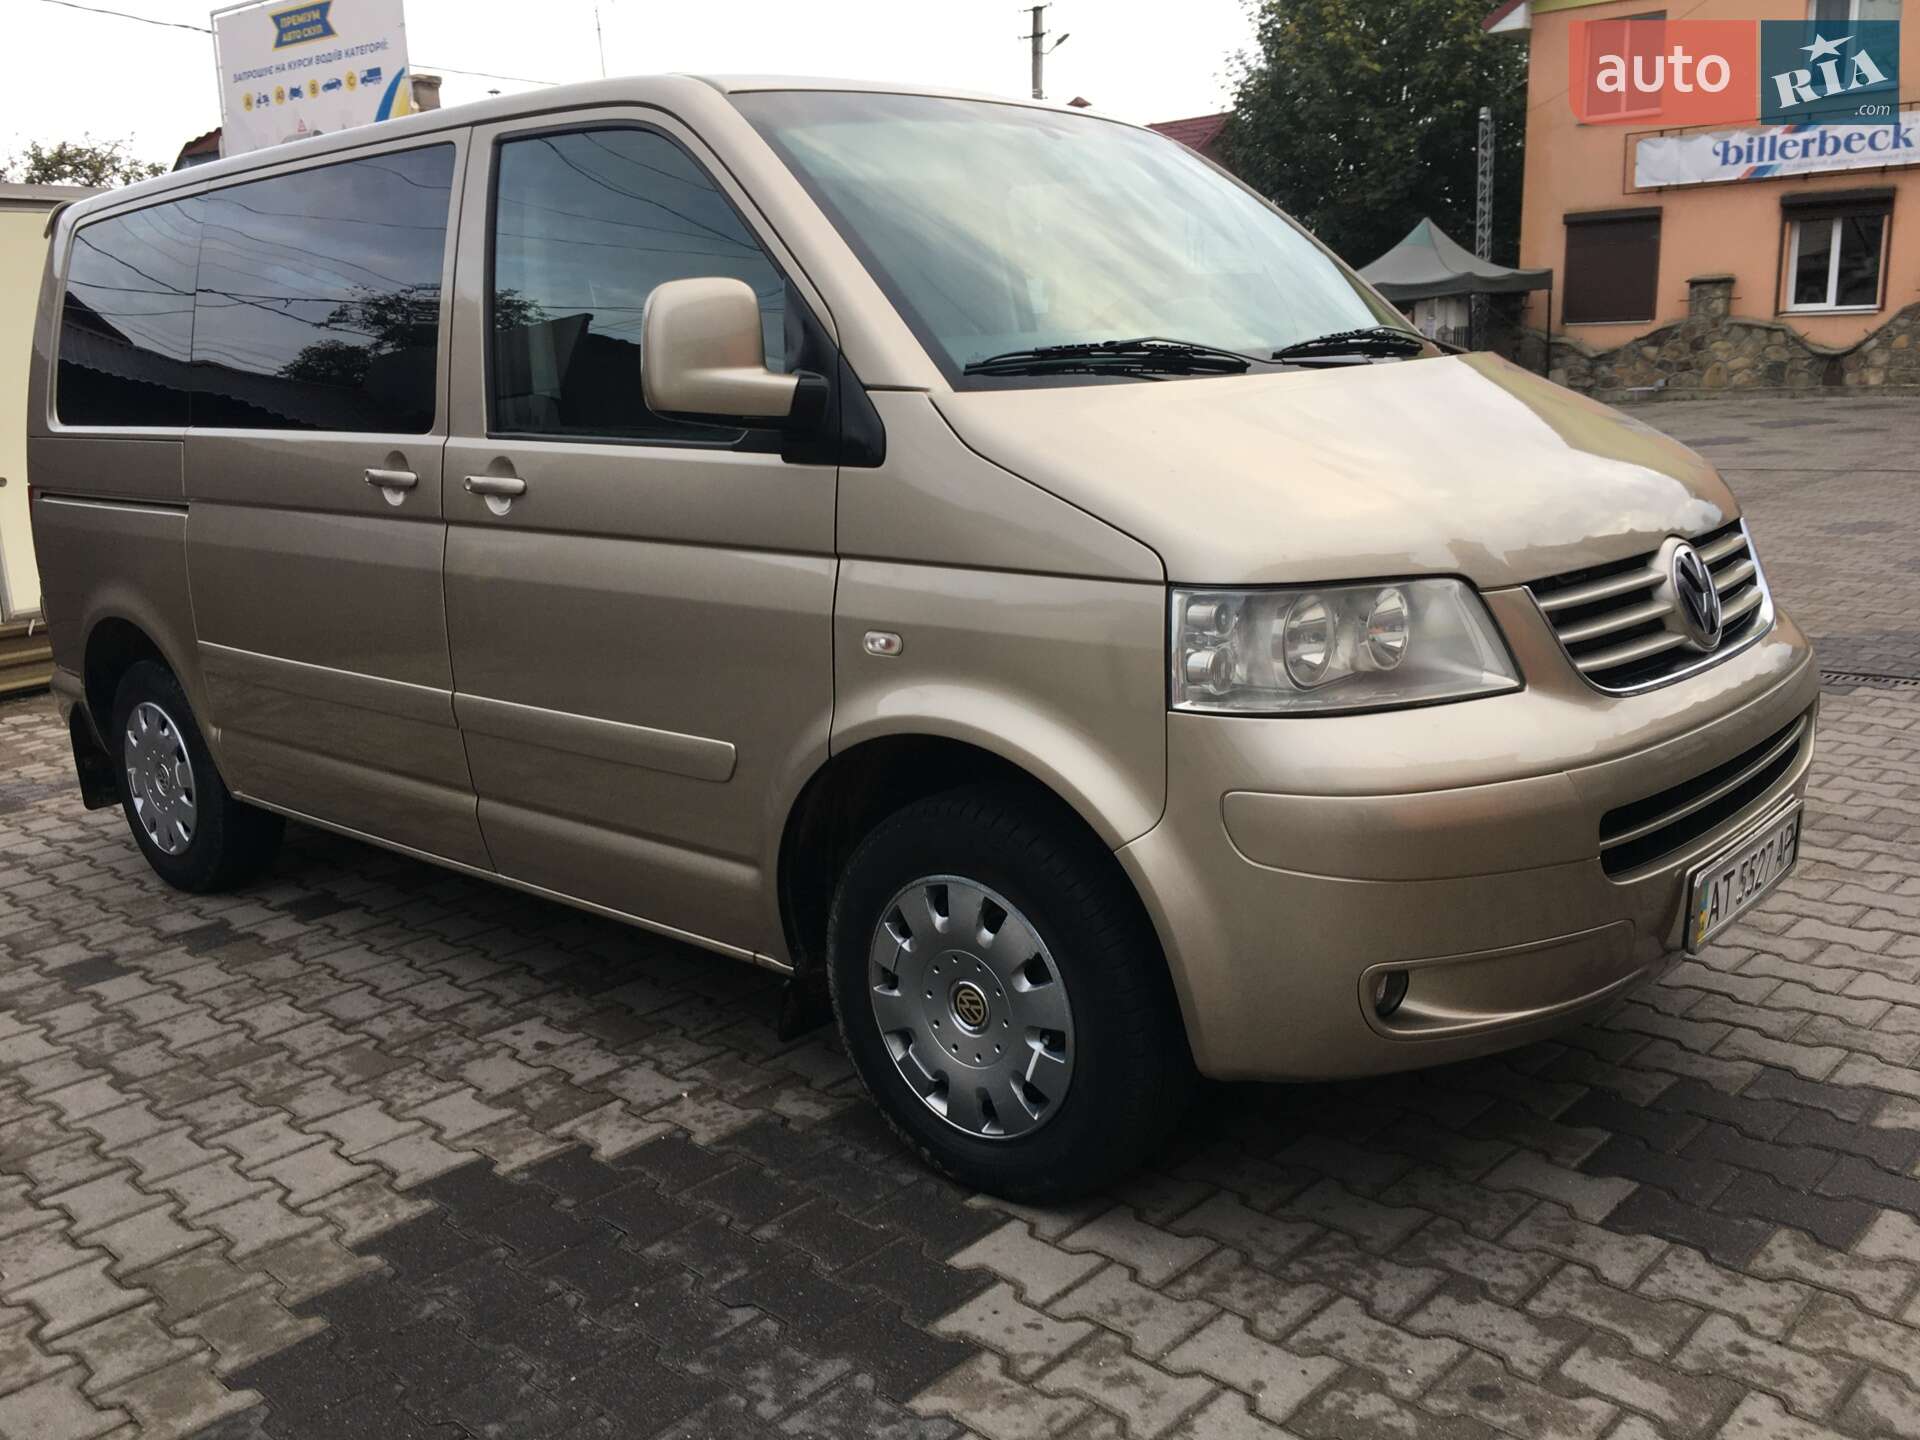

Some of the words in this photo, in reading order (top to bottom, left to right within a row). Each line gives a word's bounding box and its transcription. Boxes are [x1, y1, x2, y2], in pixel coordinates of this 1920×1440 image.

[275, 62, 286, 75] НА
[287, 56, 313, 72] КУРСИ
[1712, 122, 1914, 167] billerbeck
[1707, 868, 1736, 929] AT
[1736, 839, 1774, 905] 5527
